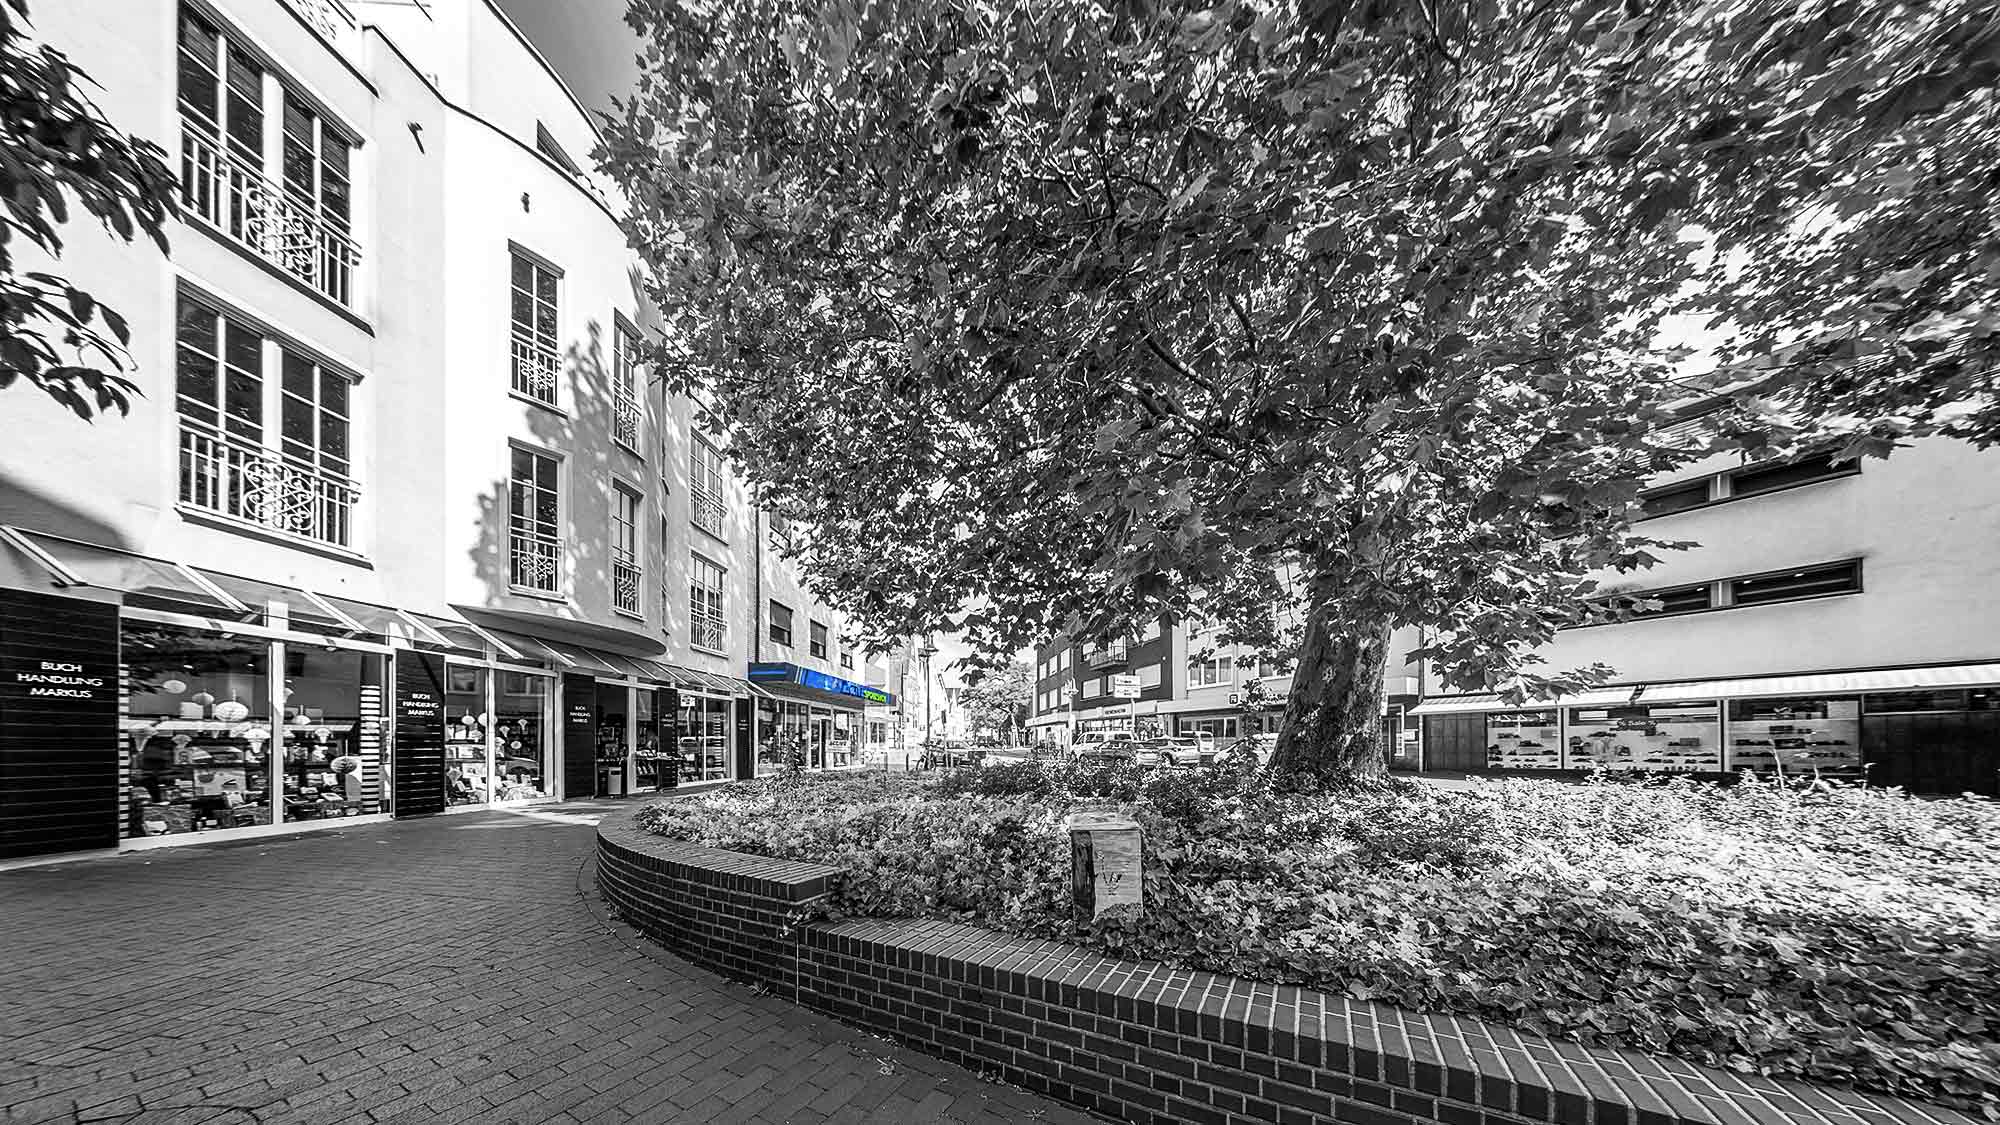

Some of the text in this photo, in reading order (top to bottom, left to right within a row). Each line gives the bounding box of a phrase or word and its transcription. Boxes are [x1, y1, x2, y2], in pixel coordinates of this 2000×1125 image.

[40, 661, 82, 672] BUCH
[16, 673, 104, 687] HANDLUNG
[29, 687, 93, 698] MARKUS
